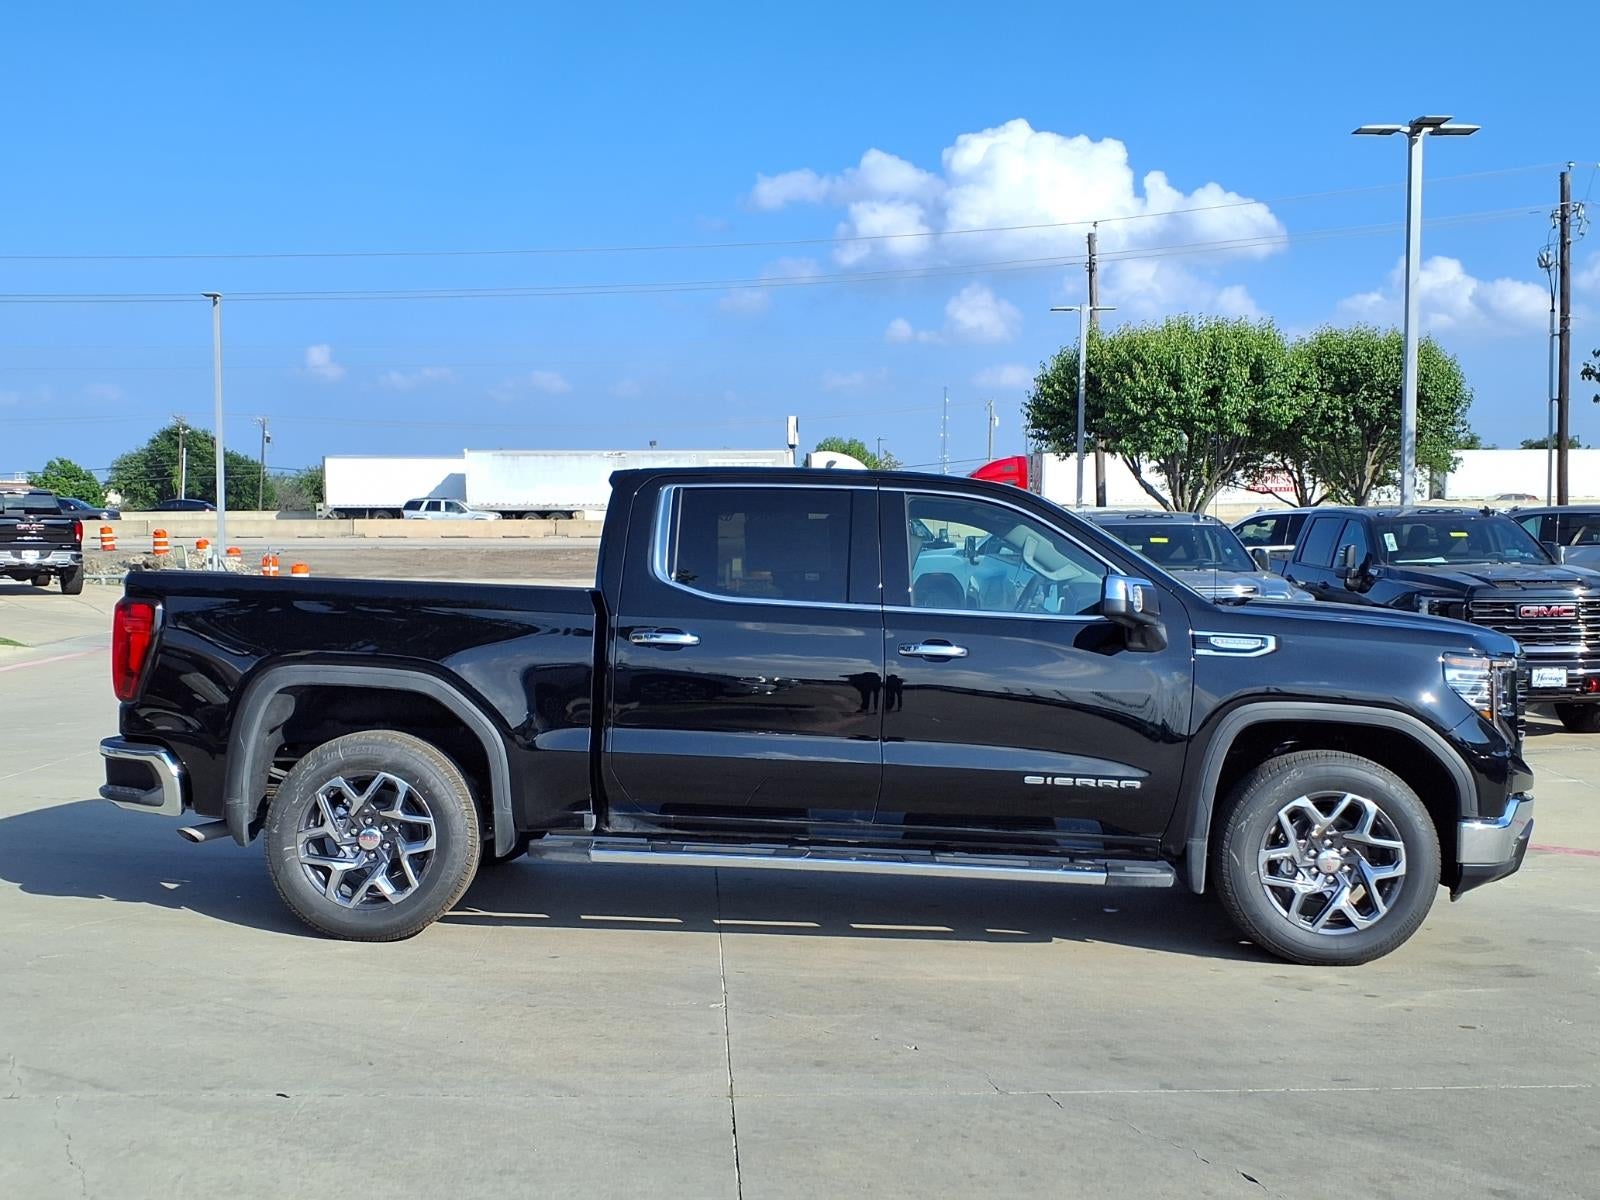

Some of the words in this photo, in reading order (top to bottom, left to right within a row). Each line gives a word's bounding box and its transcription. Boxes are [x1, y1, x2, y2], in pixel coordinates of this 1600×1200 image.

[16, 523, 45, 531] GMC
[1520, 605, 1576, 618] GMC
[1023, 775, 1142, 789] SIERRA
